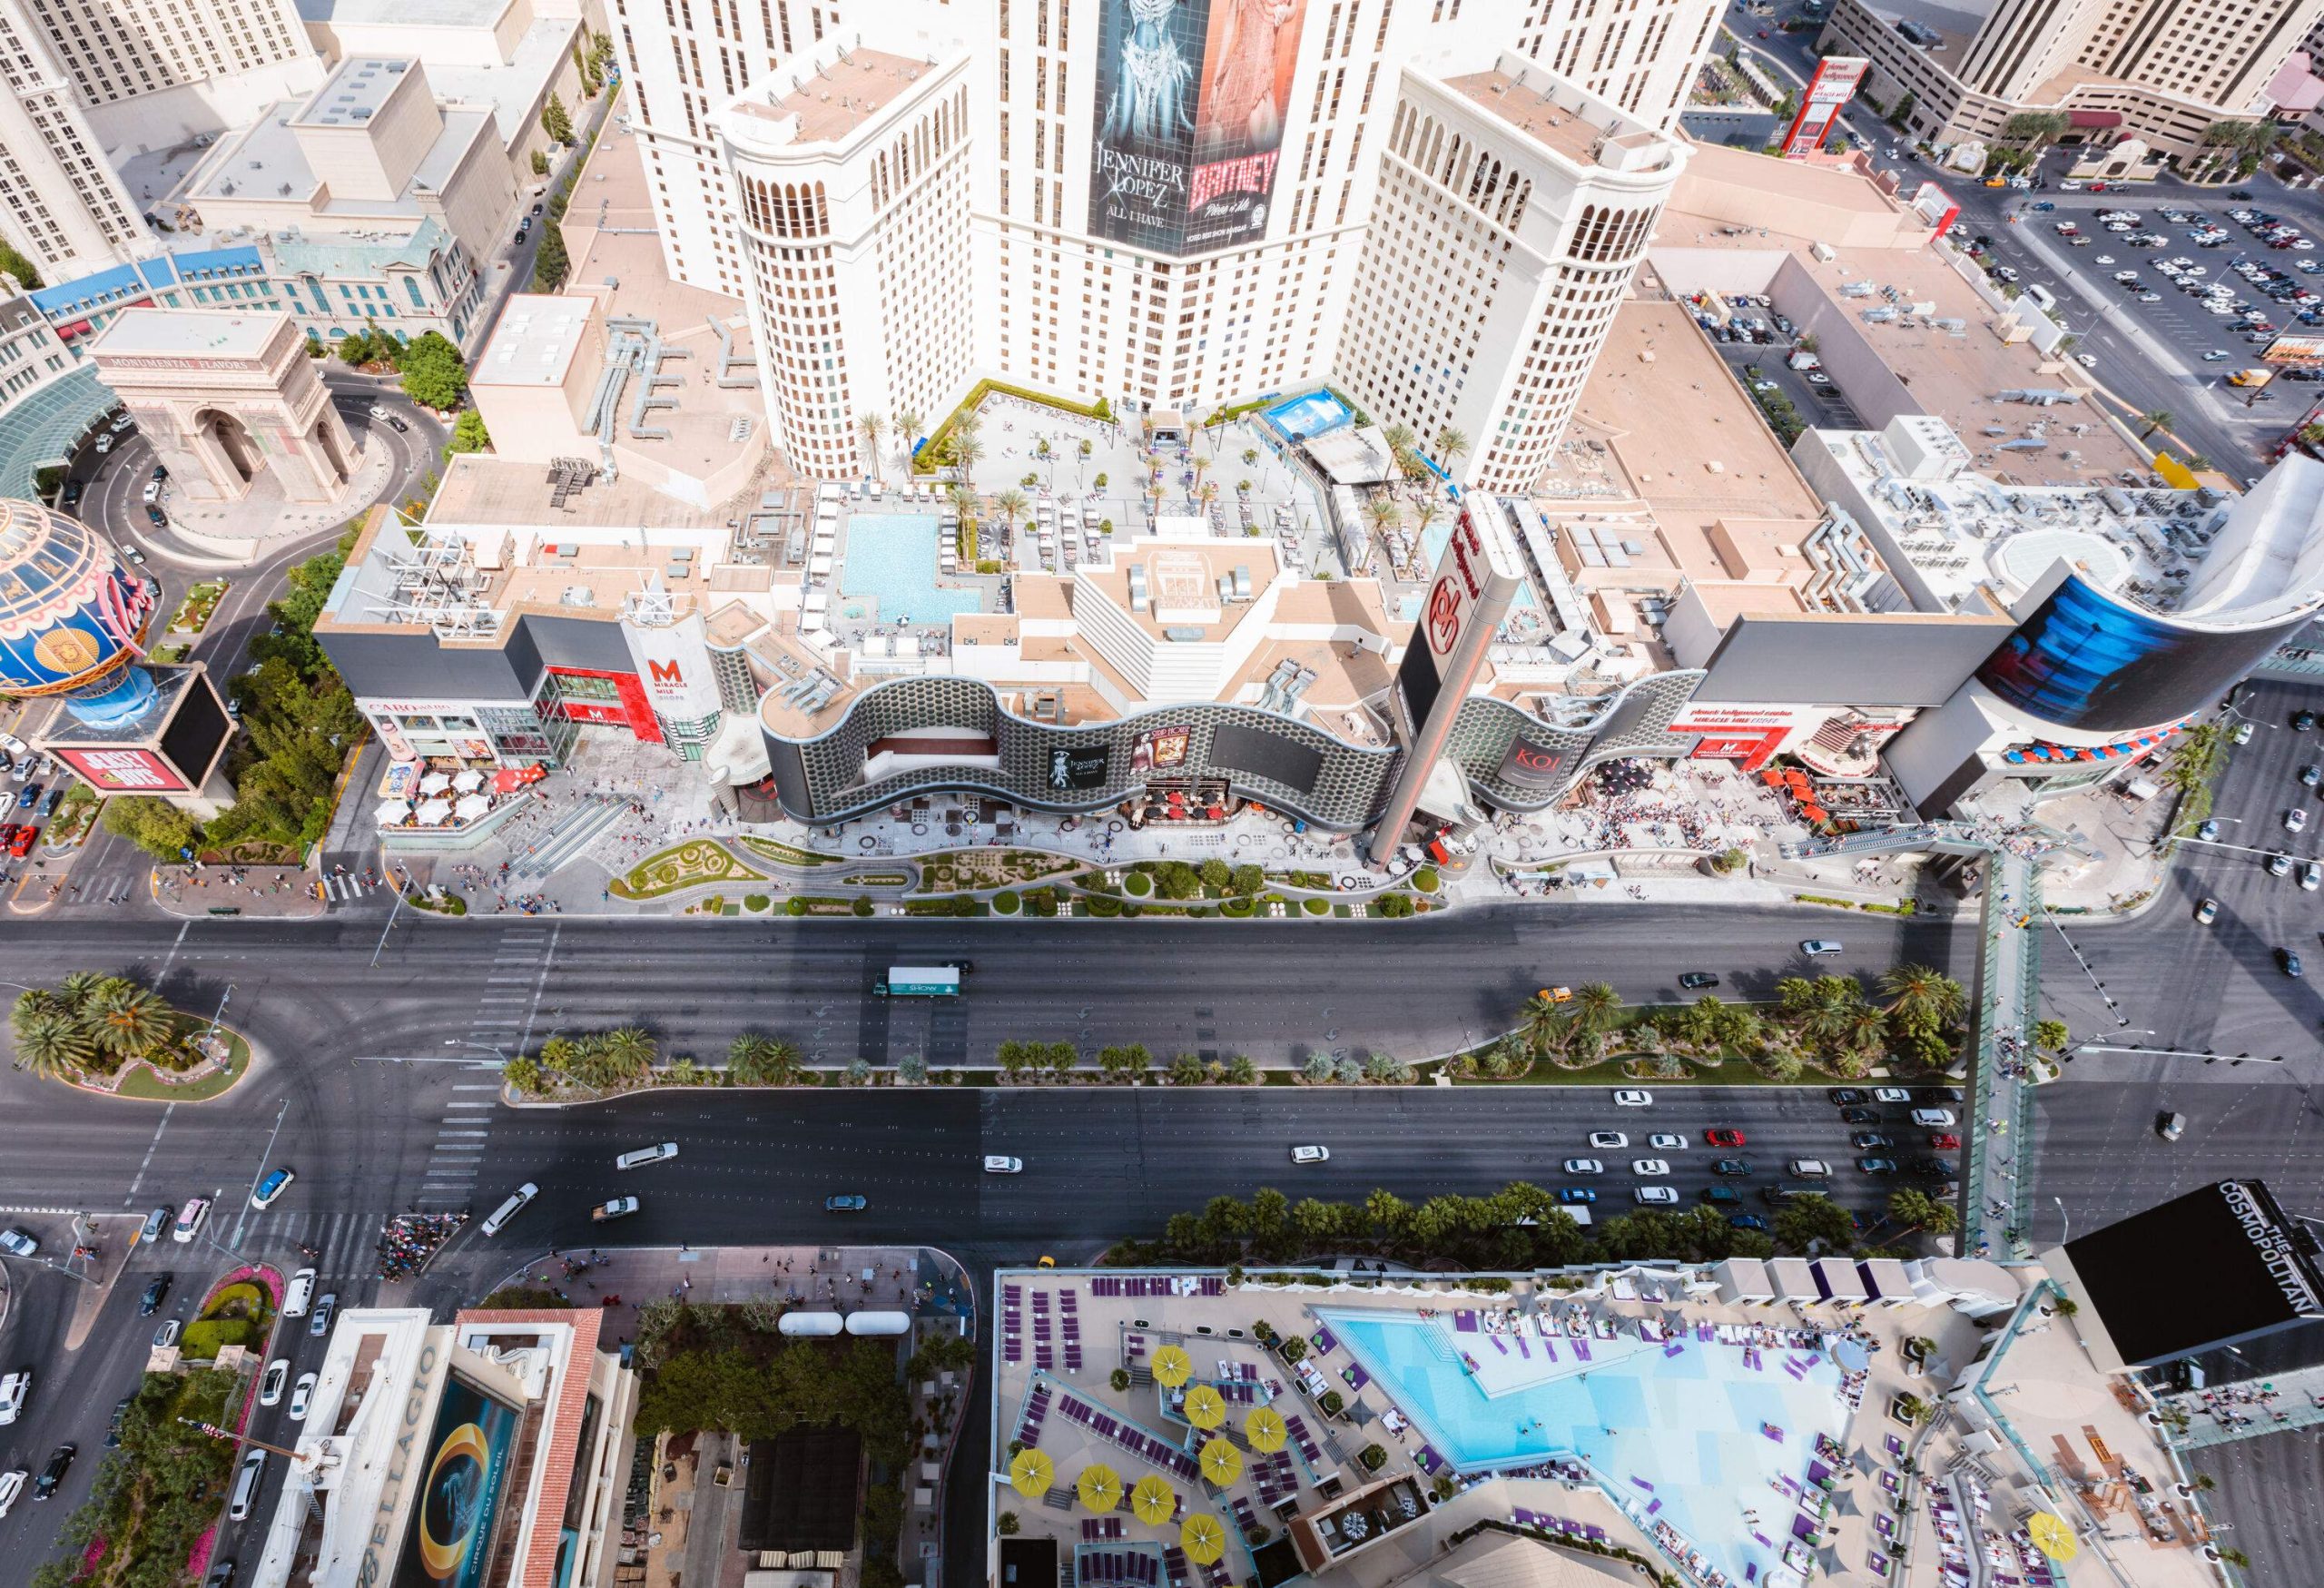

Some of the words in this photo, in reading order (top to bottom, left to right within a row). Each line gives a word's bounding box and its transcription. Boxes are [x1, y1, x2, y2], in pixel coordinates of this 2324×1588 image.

[1097, 143, 1185, 192] JENNIFER
[1112, 168, 1168, 208] LOPEZ
[1188, 149, 1279, 212] BRITNEY
[1106, 205, 1127, 220] ALL
[1130, 212, 1135, 222] I
[1137, 212, 1164, 228] HAVE
[1187, 232, 1202, 242] VOTED
[1202, 232, 1213, 240] BEST
[1212, 230, 1226, 238] SHOW
[110, 358, 194, 369] MONUMENTAL
[199, 360, 248, 370] FLAVORS
[647, 659, 683, 682] M
[369, 704, 417, 713] CABO
[476, 708, 522, 716] URBAN
[1151, 728, 1167, 738] STRIP
[1167, 726, 1191, 737] HOUSE
[80, 751, 152, 769] JERSEY
[1070, 758, 1105, 768] JENNIFER
[1516, 747, 1561, 769] KOI
[109, 769, 165, 786] BOYS
[2219, 1180, 2313, 1313] COSMOPOLITAN
[2267, 1225, 2293, 1255] THE
[355, 1346, 436, 1588] BELLAGIO
[470, 1522, 487, 1575] CIRQUE
[483, 1496, 492, 1516] DU
[488, 1448, 505, 1494] SOLEIL
